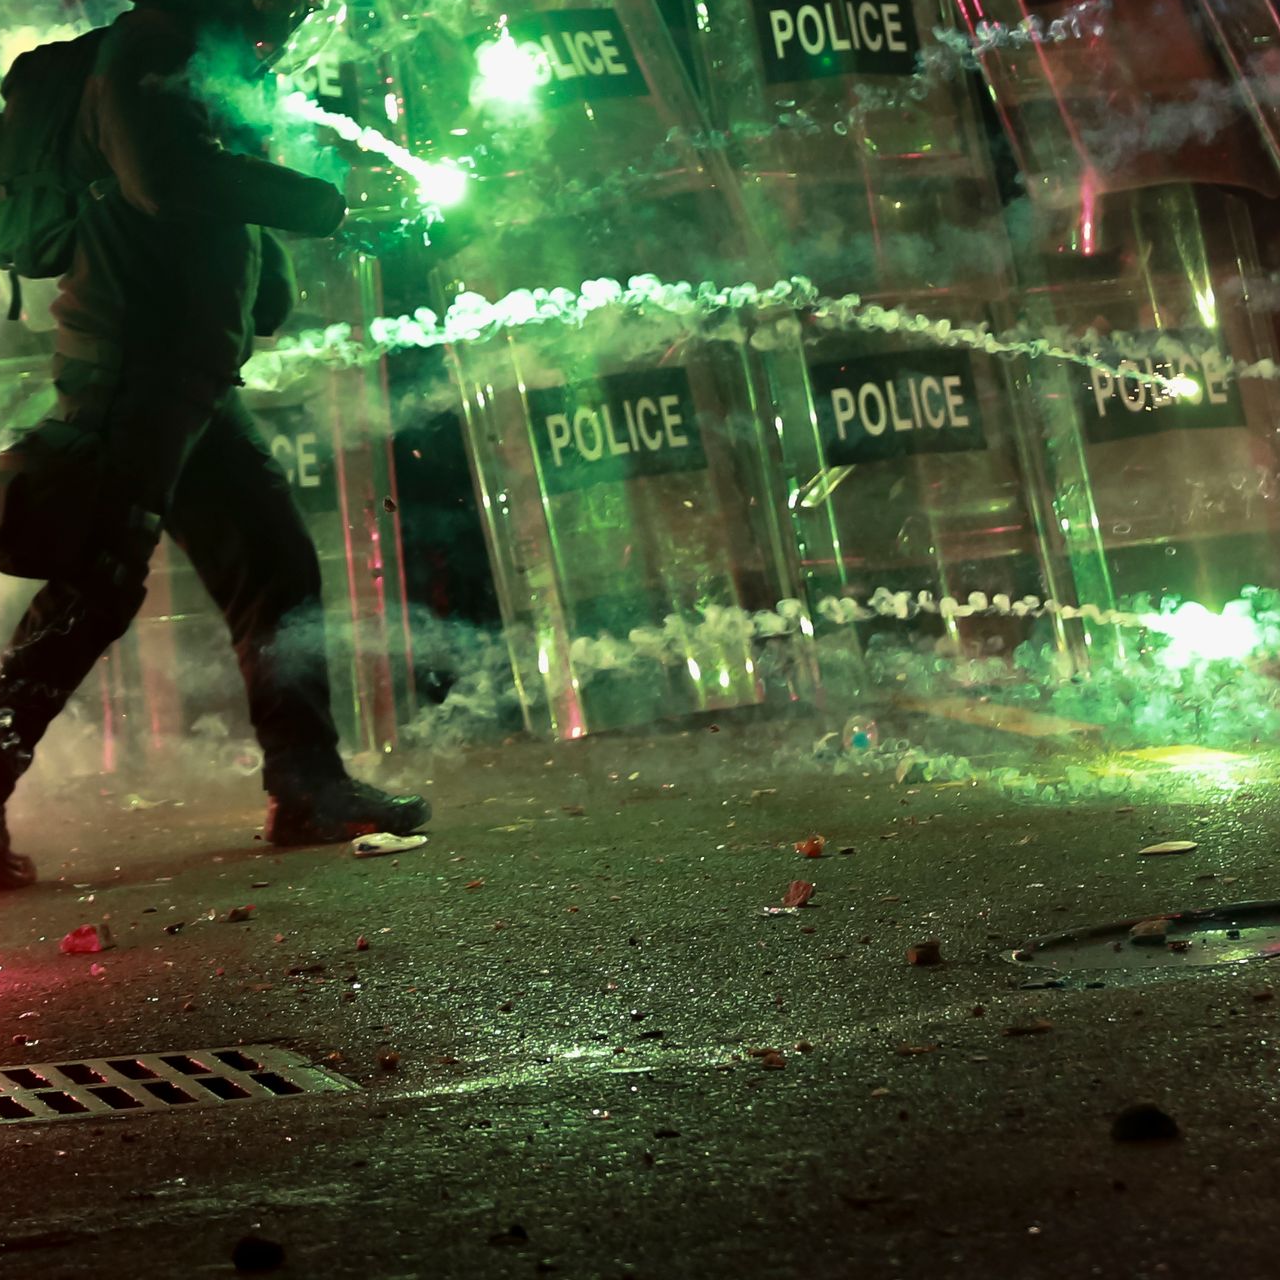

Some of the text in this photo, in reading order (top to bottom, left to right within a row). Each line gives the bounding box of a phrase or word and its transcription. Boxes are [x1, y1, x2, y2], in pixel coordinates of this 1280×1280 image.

[769, 1, 908, 59] POLICE
[545, 394, 689, 467] POLICE
[830, 375, 969, 440] POLICE
